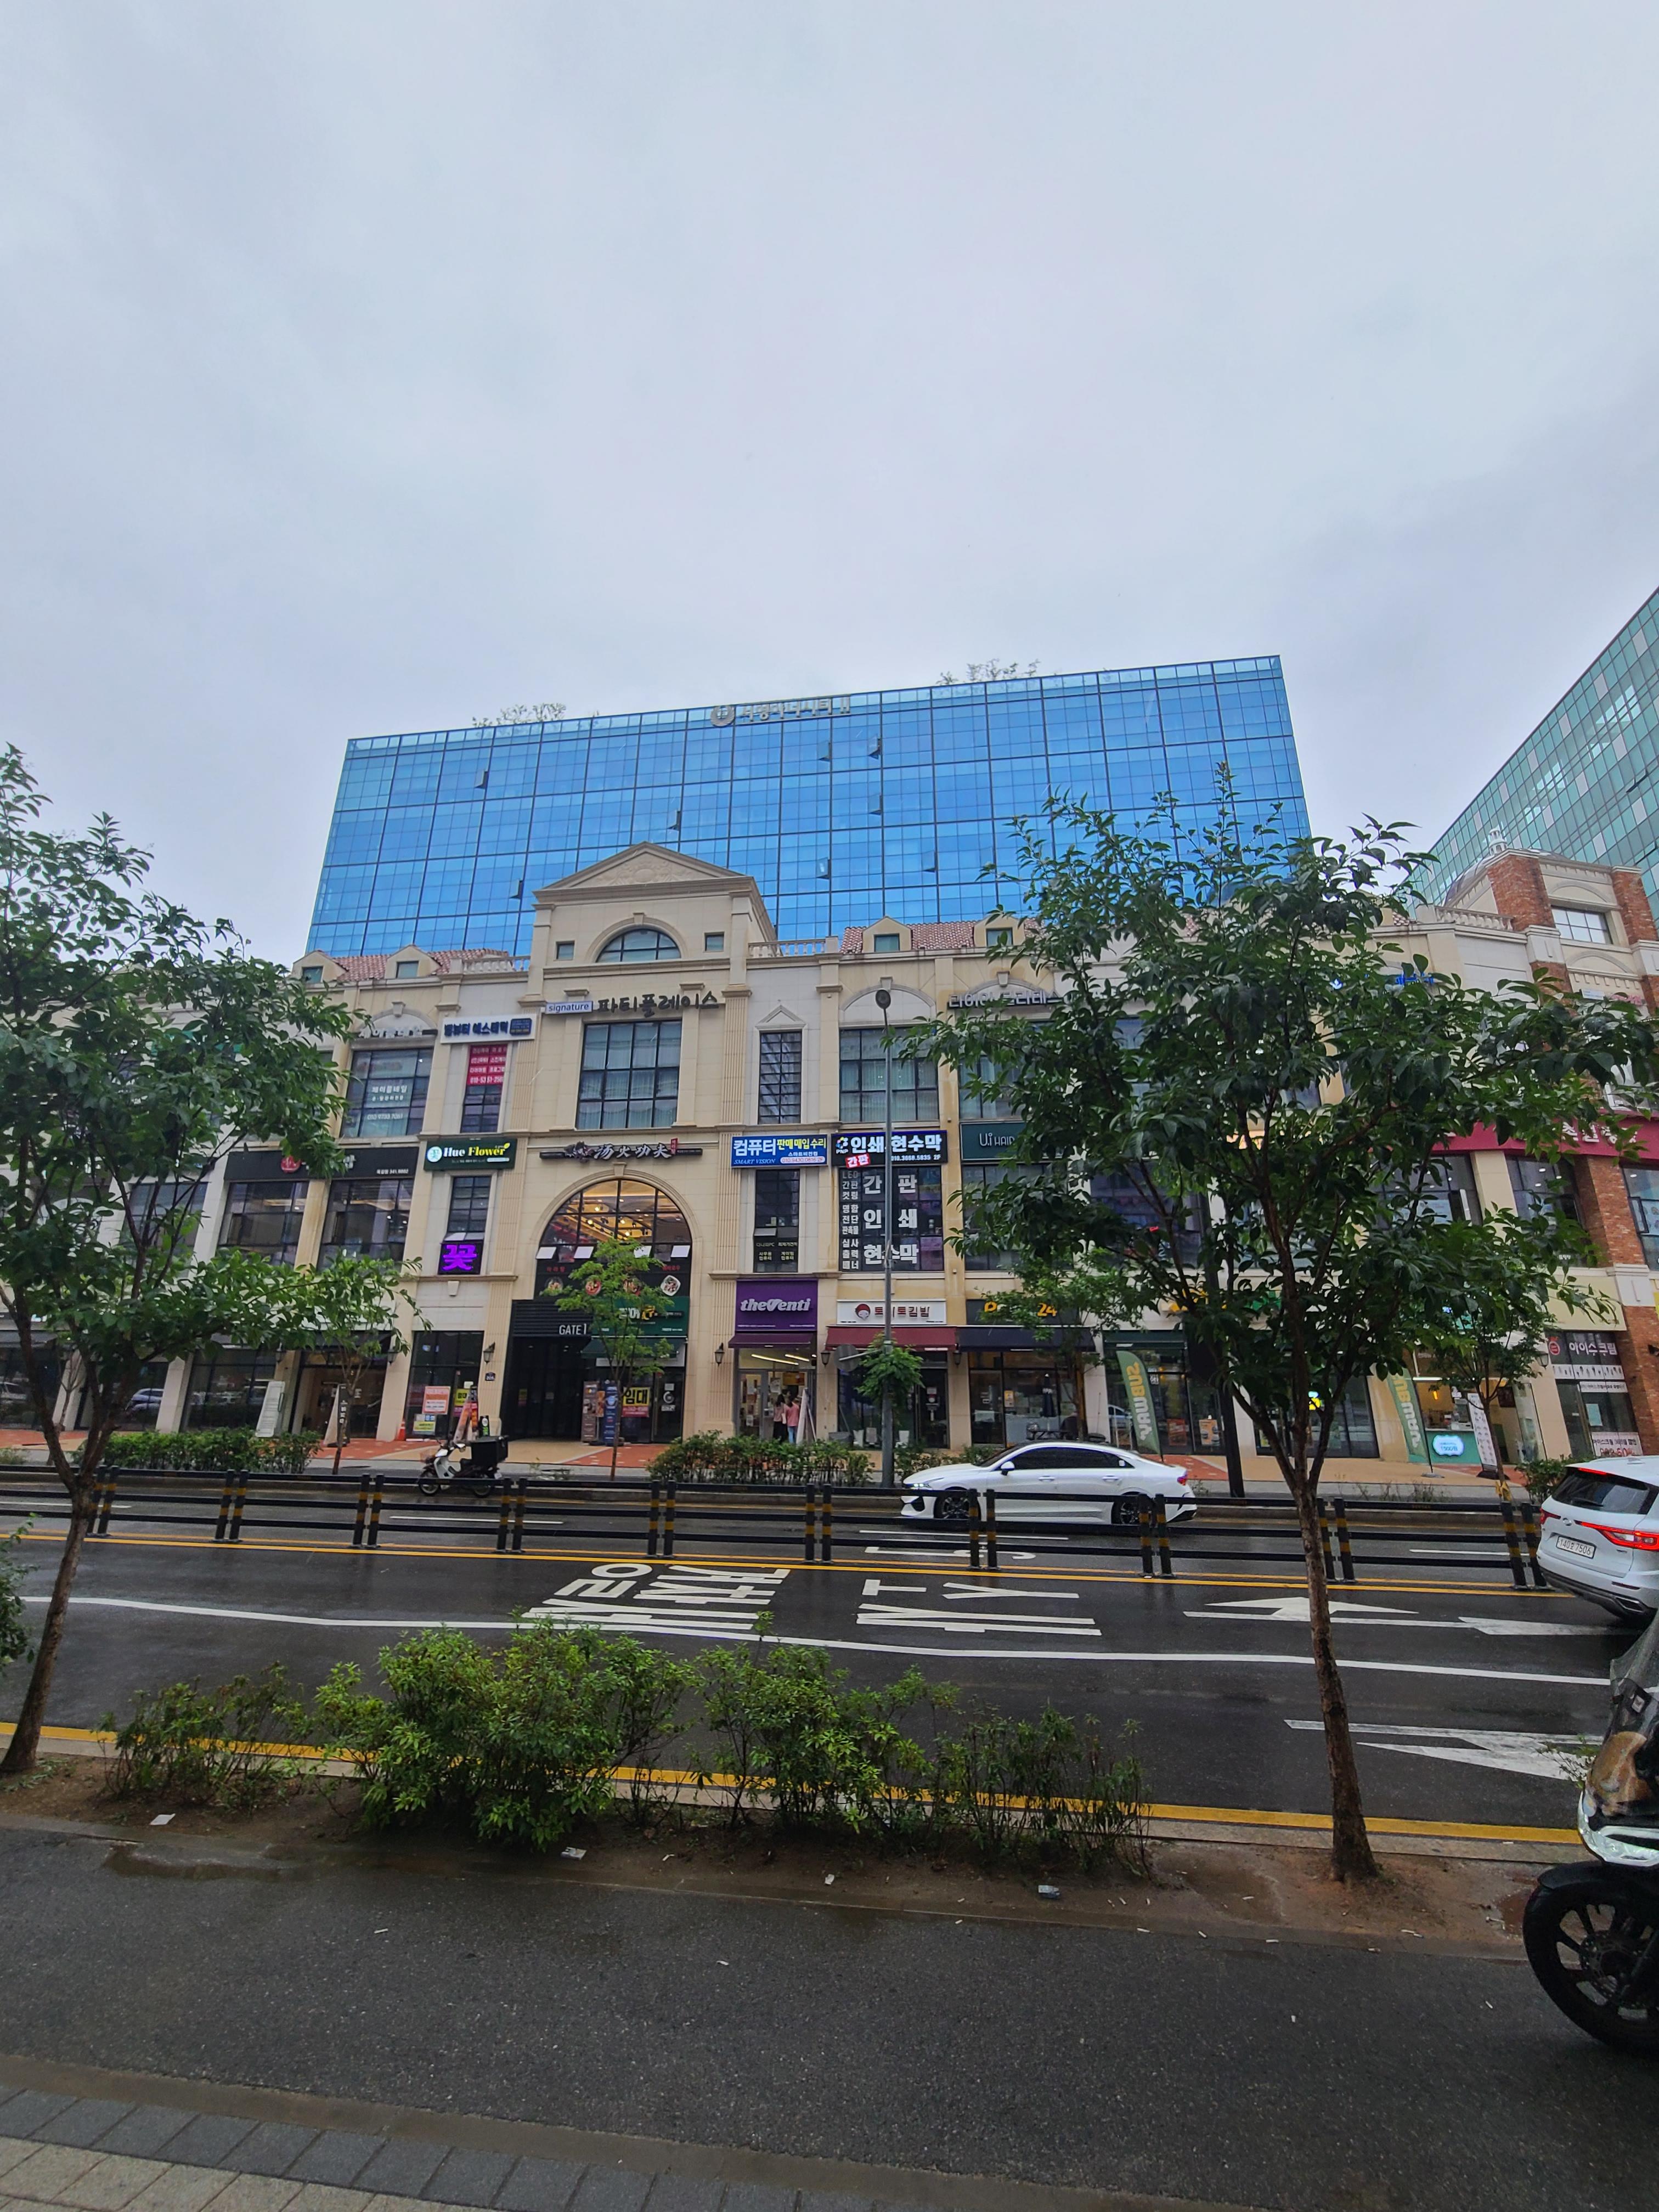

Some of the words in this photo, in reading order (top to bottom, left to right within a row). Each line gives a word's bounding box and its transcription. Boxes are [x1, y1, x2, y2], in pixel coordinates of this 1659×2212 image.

[548, 1003, 589, 1013] signature
[597, 991, 719, 1018] 파티플레이스
[733, 1138, 777, 1156] 컴퓨터
[777, 1139, 793, 1150] 판매
[794, 1138, 809, 1150] 매입
[810, 1138, 827, 1149] 수리
[850, 1136, 884, 1153] 인쇄
[891, 1134, 943, 1152] 현수막
[443, 1147, 466, 1157] Hue
[468, 1146, 506, 1156] Flower
[847, 1154, 869, 1166] 간판
[842, 1171, 859, 1179] LED
[842, 1181, 859, 1189] 간판
[842, 1204, 859, 1214] 명함
[842, 1215, 859, 1224] 전단
[842, 1238, 859, 1248] 실사
[443, 1244, 477, 1271] 꽃
[842, 1249, 859, 1259] 출력
[558, 1324, 582, 1335] GATE
[623, 1388, 648, 1404] 임대
[1575, 1542, 1592, 1556] 7506
